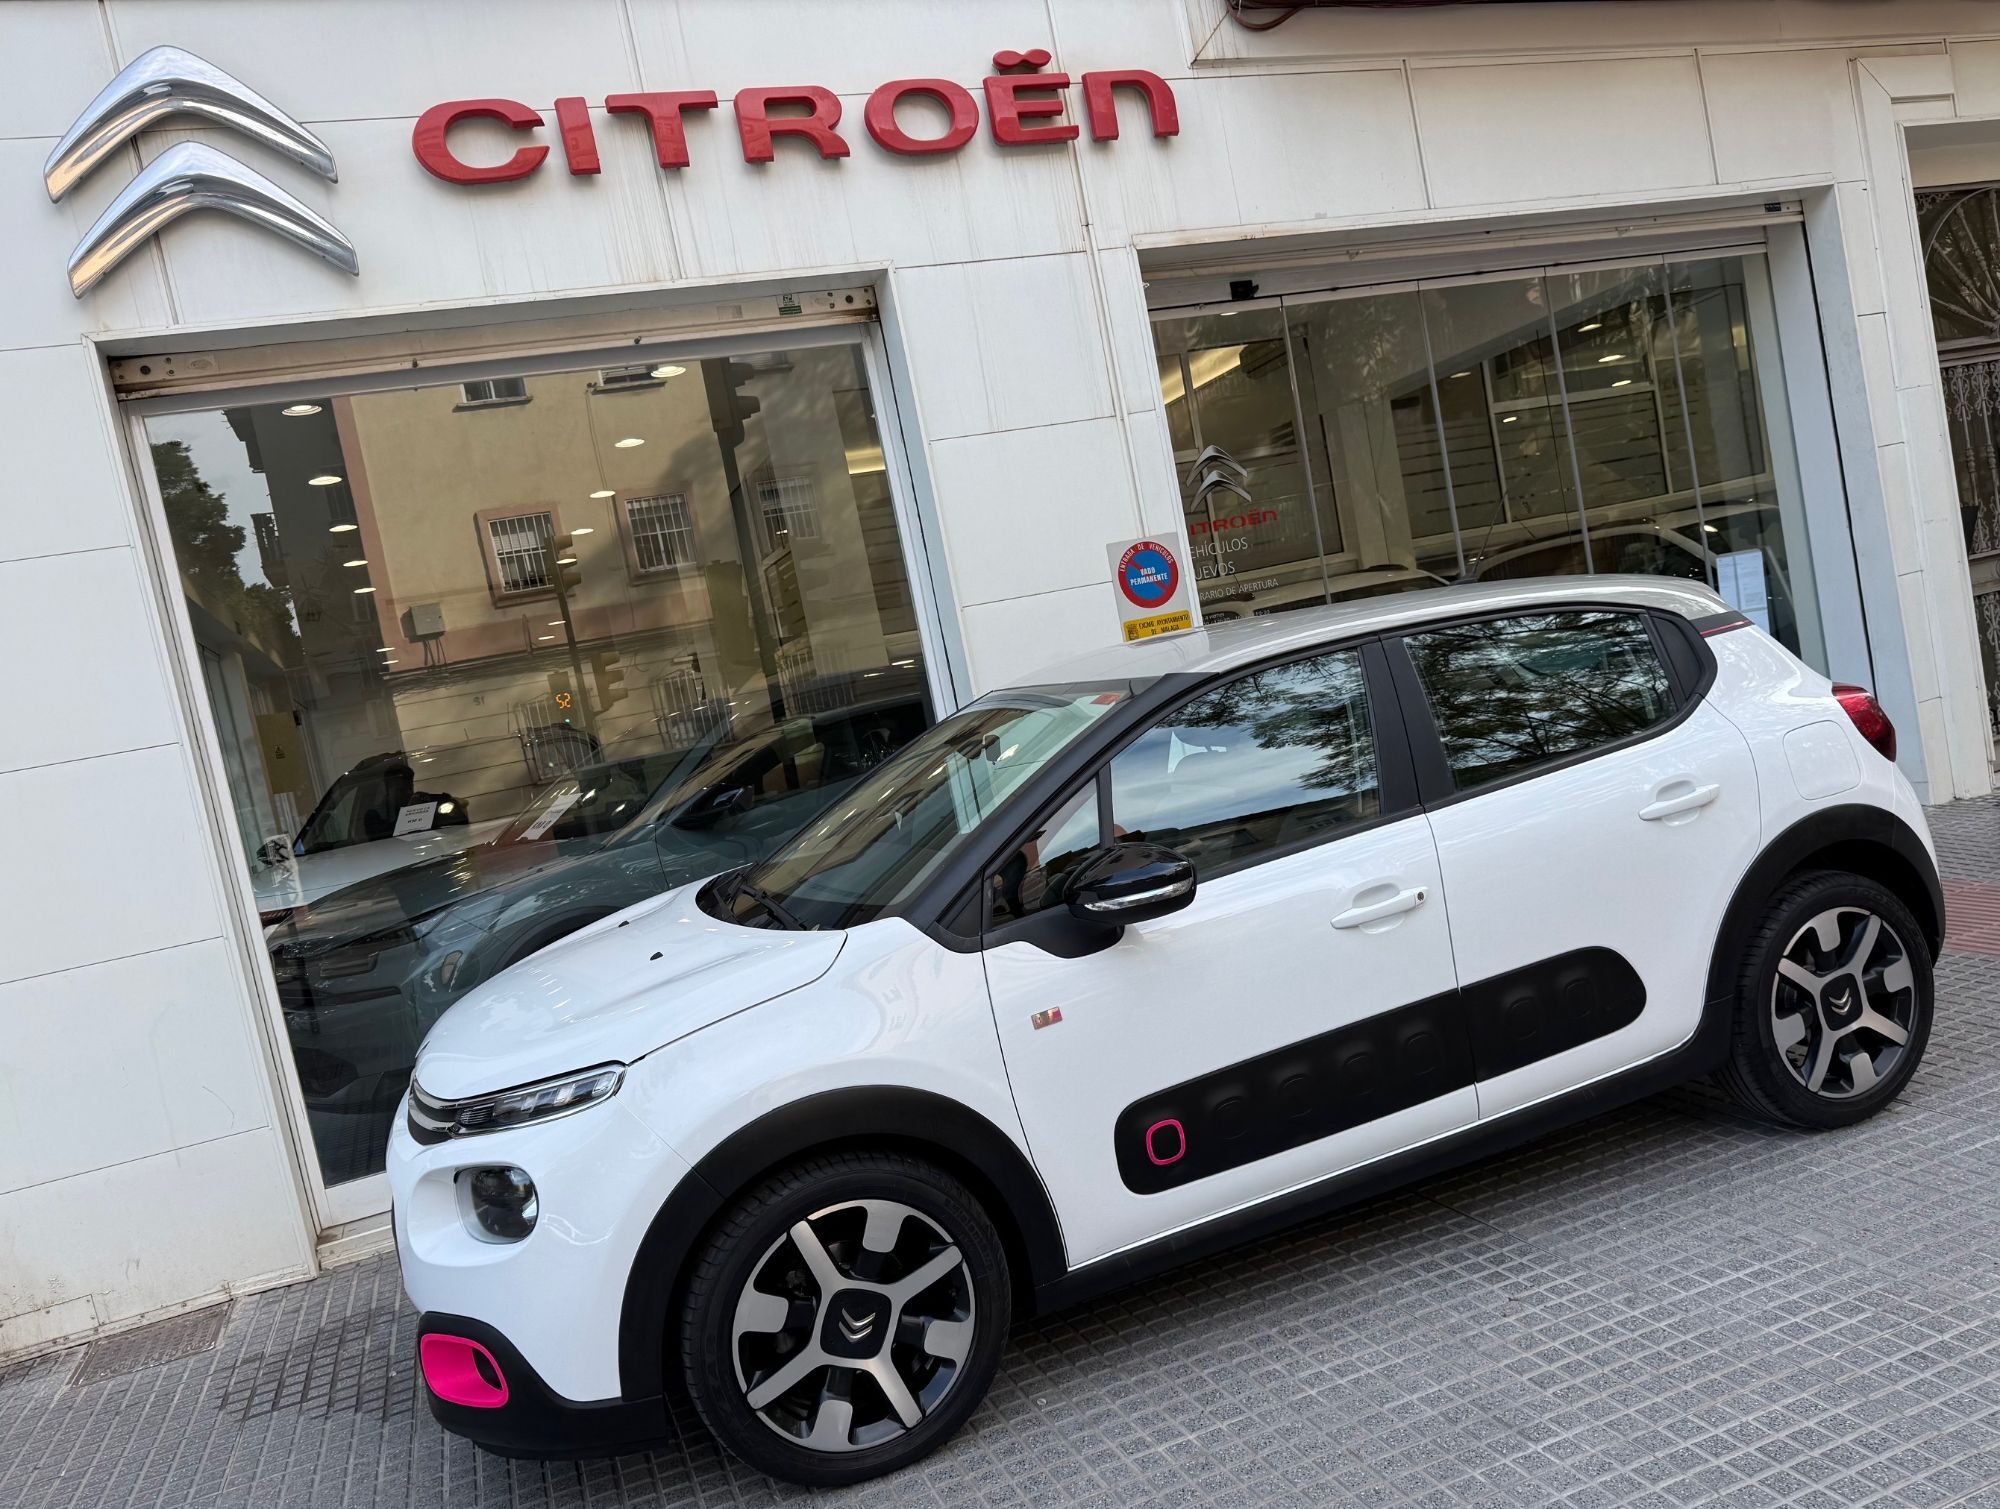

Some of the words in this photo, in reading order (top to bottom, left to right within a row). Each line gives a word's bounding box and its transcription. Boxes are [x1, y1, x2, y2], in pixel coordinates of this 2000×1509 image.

[1190, 509, 1278, 536] ITROËN
[1190, 537, 1248, 559] EHÍCULOS
[1130, 572, 1168, 586] PERMANENTE
[1140, 566, 1156, 575] VADO
[1195, 561, 1235, 580] UEVOS
[1200, 590, 1224, 600] RARIO
[1226, 587, 1236, 595] DE
[1238, 578, 1279, 594] APERTURA
